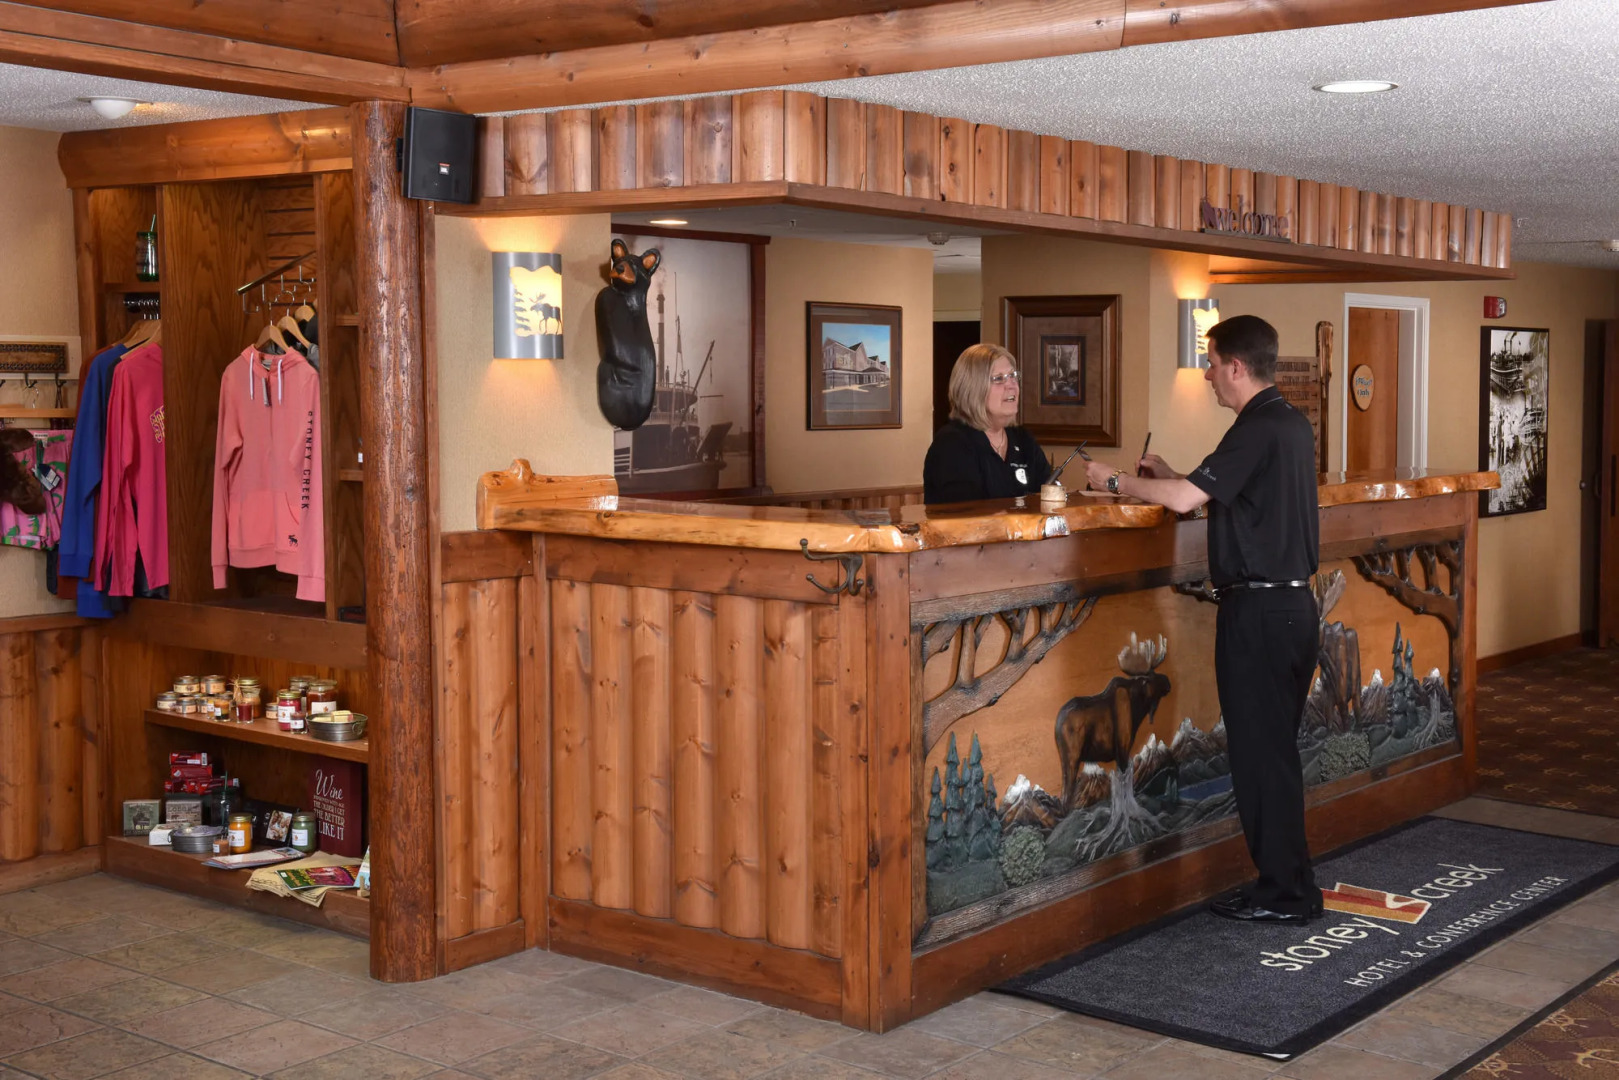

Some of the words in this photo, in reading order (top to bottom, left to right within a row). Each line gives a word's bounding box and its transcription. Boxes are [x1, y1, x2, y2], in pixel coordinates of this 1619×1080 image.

[1211, 195, 1290, 238] welcome
[301, 469, 311, 509] CREEK
[315, 769, 344, 800] Wine
[314, 808, 324, 820] THE
[324, 812, 345, 827] BETTER
[336, 808, 345, 816] GET
[318, 821, 336, 838] LIKE
[337, 826, 344, 841] IT
[1260, 917, 1400, 971] stoney
[1410, 863, 1504, 899] creek
[1344, 958, 1411, 987] HOTEL
[1400, 950, 1427, 958] &
[1416, 900, 1520, 949] CONFERENCE
[1510, 876, 1568, 900] CENTER
